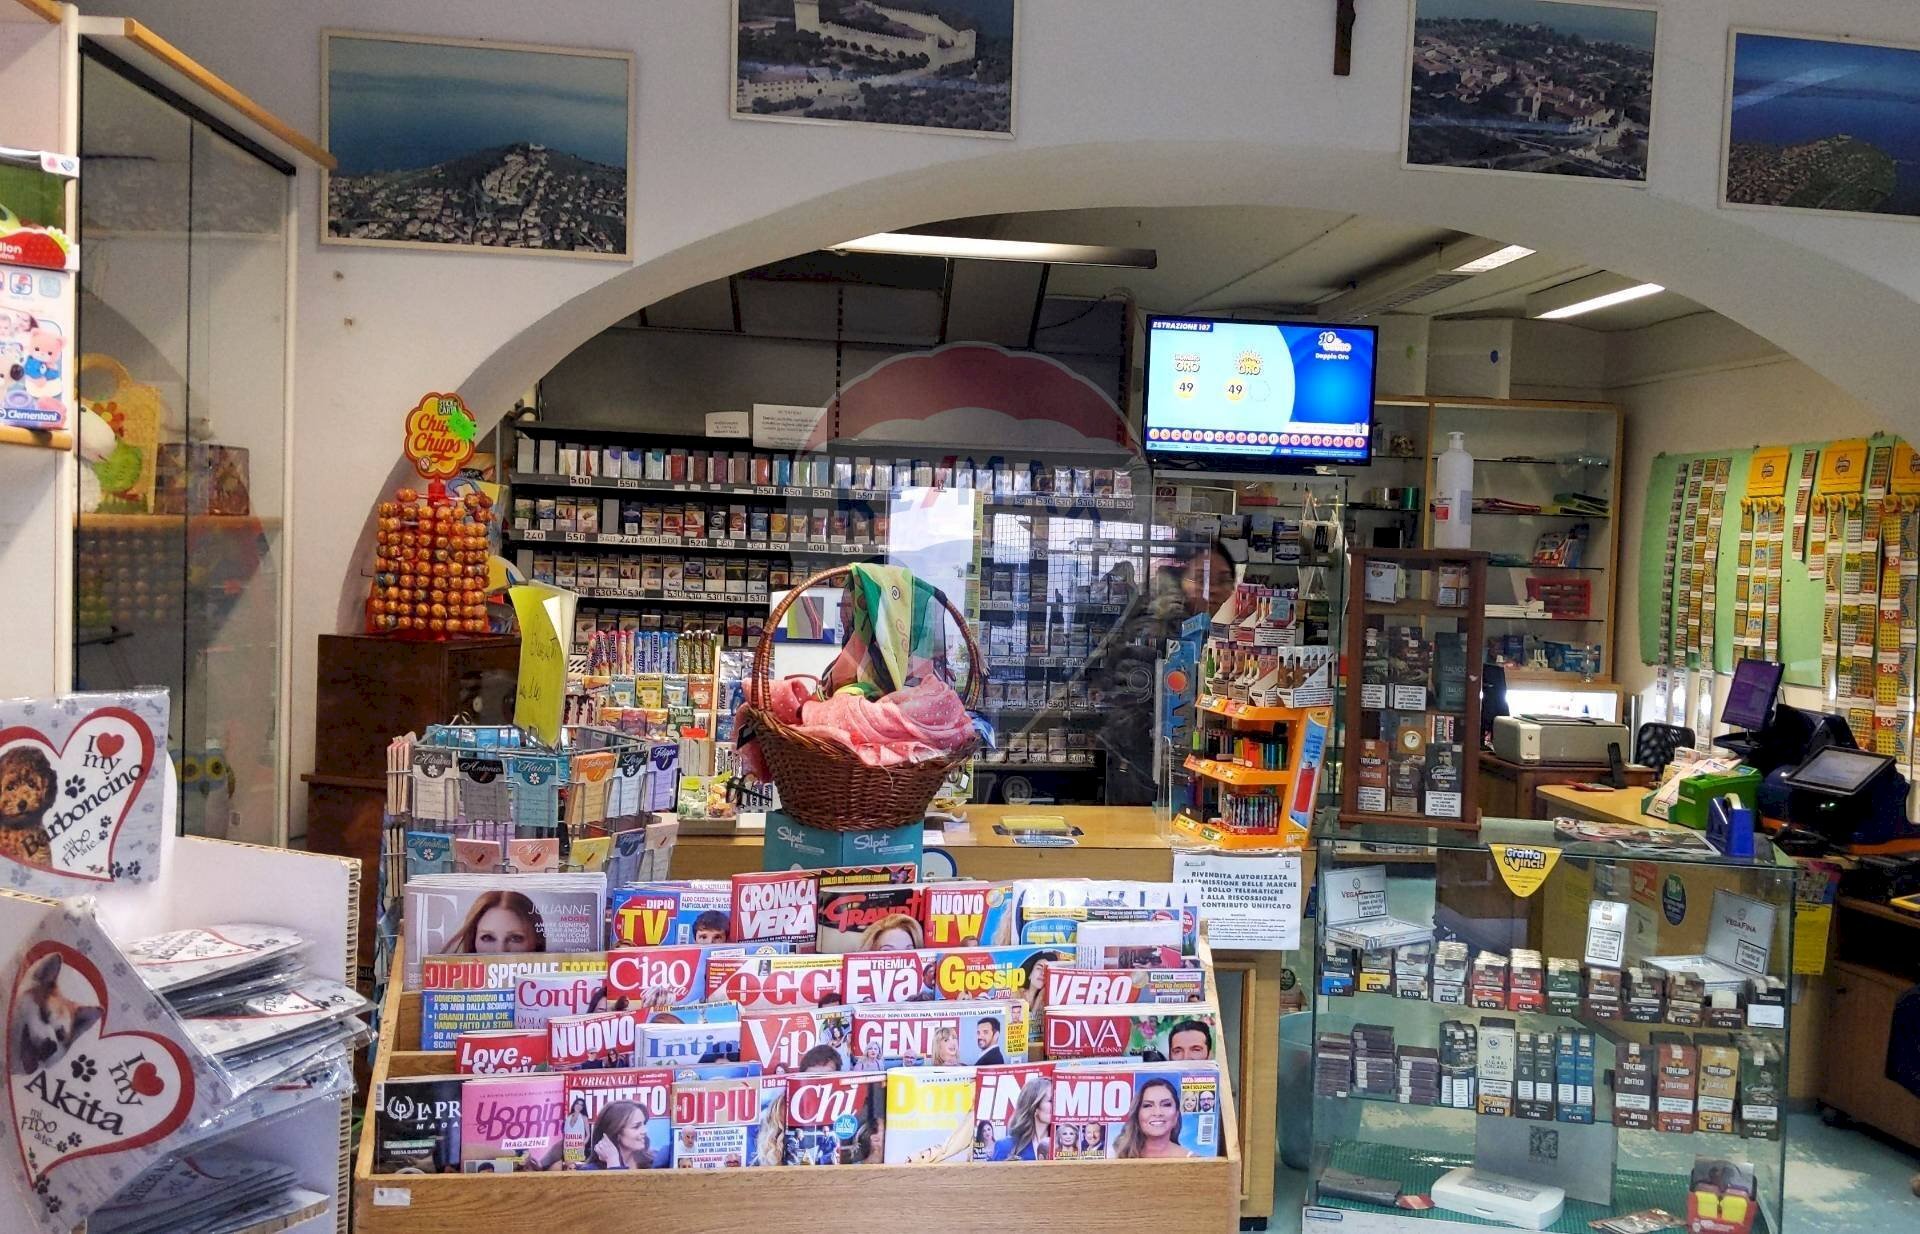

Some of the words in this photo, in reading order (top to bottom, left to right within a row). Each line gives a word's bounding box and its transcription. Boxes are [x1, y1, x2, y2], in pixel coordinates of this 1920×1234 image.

[1153, 321, 1197, 330] ESTRAZIONE
[1176, 362, 1201, 373] ORO
[1179, 382, 1194, 392] 49
[1228, 384, 1243, 394] 49
[8, 409, 57, 421] Clementoni
[418, 413, 452, 437] Chu
[414, 432, 460, 453] Chups
[619, 480, 637, 488] 550
[758, 487, 774, 495] 550
[784, 488, 801, 496] 550
[814, 489, 830, 497] 550
[567, 533, 585, 541] 550
[596, 589, 612, 597] 530
[627, 589, 644, 597] 530
[85, 734, 97, 753] I
[82, 753, 122, 775] my
[20, 763, 144, 858] Barboncino
[1506, 848, 1541, 859] Gratta
[1509, 853, 1545, 872] Vinci!
[1191, 871, 1232, 880] RIVENDITA
[1235, 873, 1288, 881] AUTORIZZATA
[646, 898, 675, 910] DIPIÙ
[740, 879, 817, 912] CRONACA
[931, 894, 985, 915] NUOVO
[527, 904, 591, 916] JULIANNE
[618, 909, 669, 945] TV
[740, 909, 817, 938] VERA
[930, 914, 983, 943] TV
[424, 959, 486, 989] DIPIÙ
[609, 957, 691, 991] Ciao
[870, 959, 917, 970] TREMILA
[939, 955, 1026, 994] Gossip
[725, 970, 842, 1006] OGG
[848, 960, 919, 1003] Eva
[1050, 974, 1133, 1004] VERO
[467, 1002, 486, 1011] DALLA
[496, 1012, 509, 1020] CHE
[460, 1021, 480, 1029] FATTO
[482, 1021, 491, 1029] LA
[1050, 1019, 1122, 1049] DIVA
[551, 1015, 635, 1058] NUOVO
[742, 1017, 817, 1075] Vip
[123, 1050, 146, 1069] I
[461, 1042, 519, 1065] Love
[108, 1062, 144, 1107] my
[572, 1074, 636, 1087] L'ORIGINALE
[24, 1070, 124, 1136] Akita
[676, 1082, 757, 1125] DIPIÙ
[790, 1082, 857, 1125] Chi
[1056, 1080, 1131, 1117] MIO
[417, 1103, 432, 1120] LA
[21, 1116, 58, 1134] FIDO
[486, 1117, 565, 1141] Donn
[504, 1139, 547, 1149] MAGAZINE
